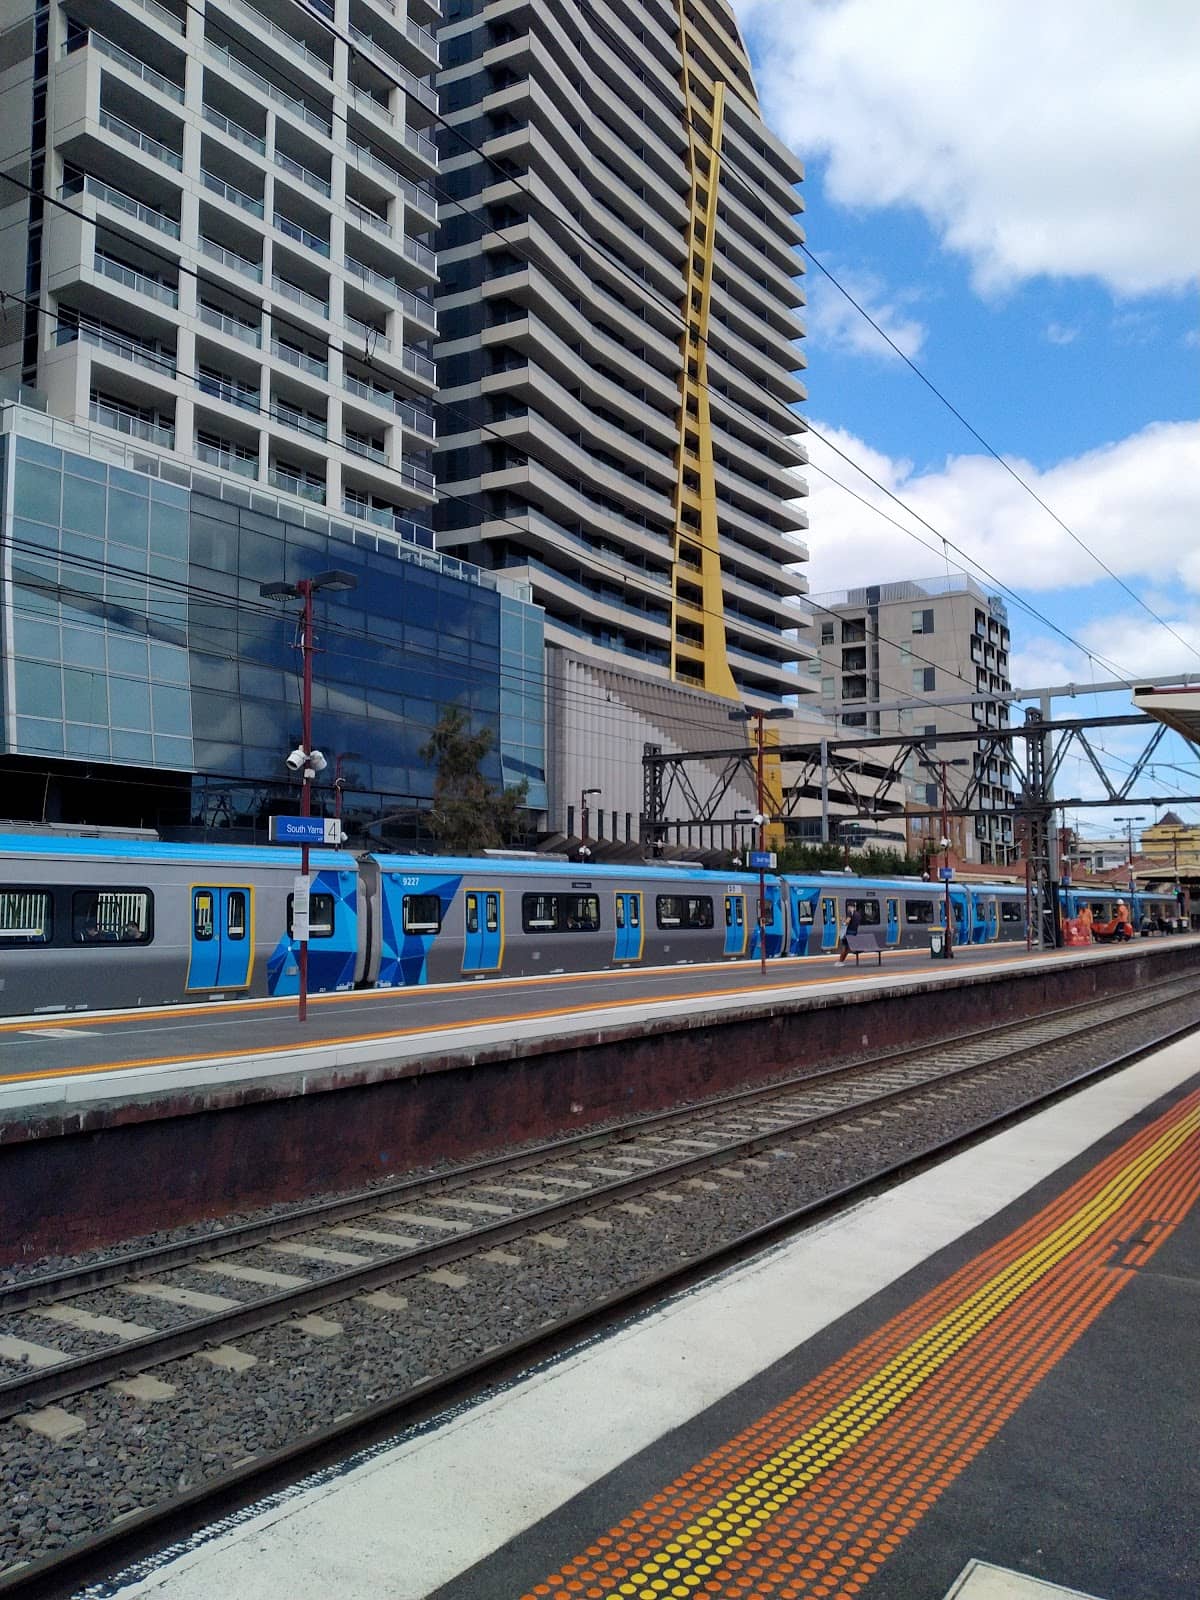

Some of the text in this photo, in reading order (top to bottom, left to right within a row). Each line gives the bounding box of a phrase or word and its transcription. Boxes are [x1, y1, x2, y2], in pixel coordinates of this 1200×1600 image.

[286, 824, 306, 833] South
[328, 822, 338, 841] 4
[402, 877, 419, 886] 9227
